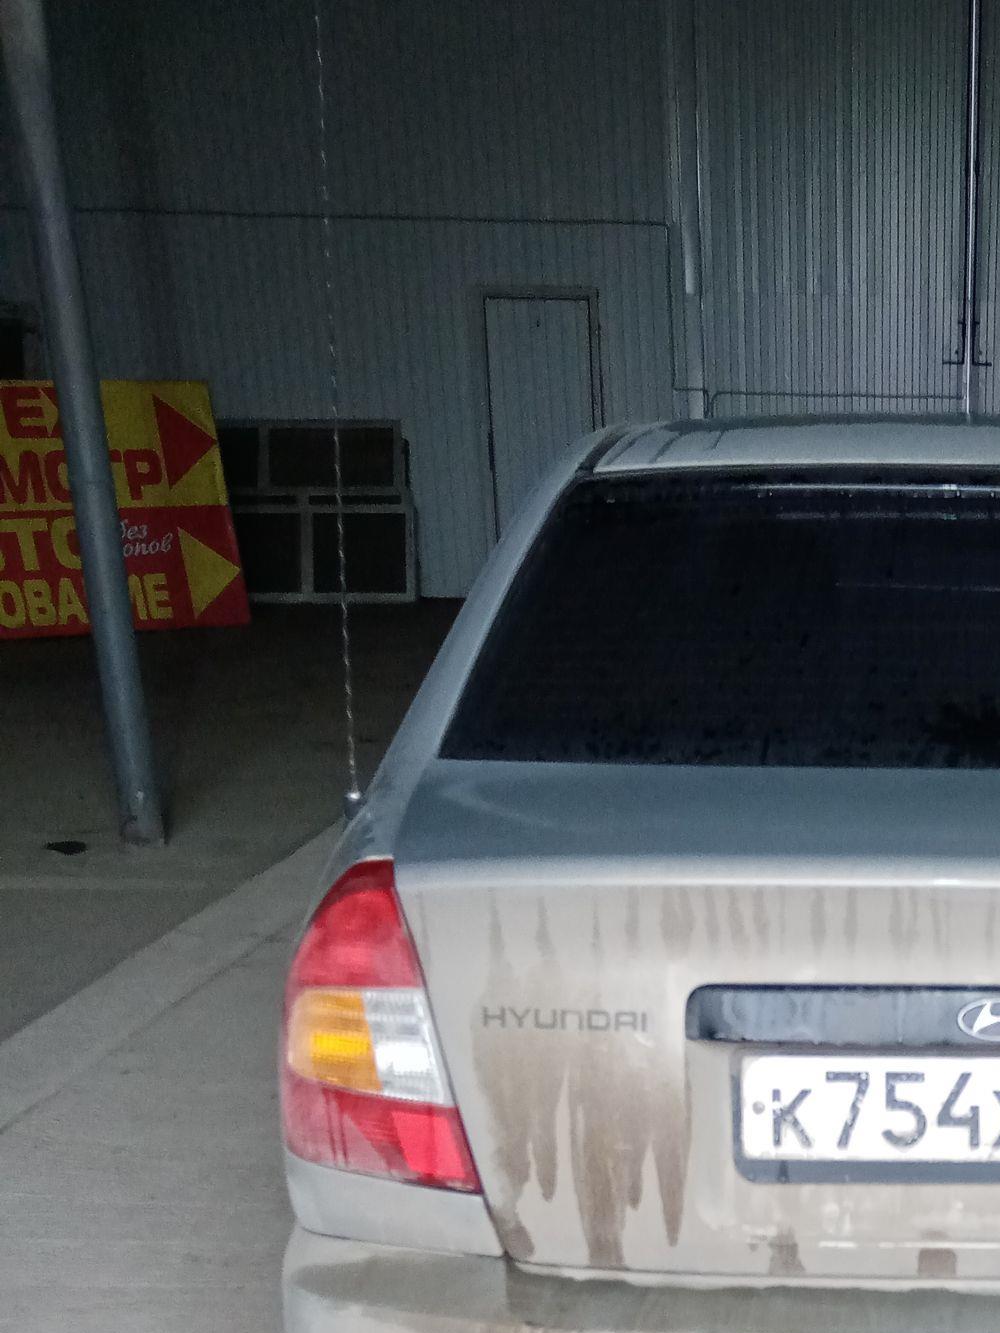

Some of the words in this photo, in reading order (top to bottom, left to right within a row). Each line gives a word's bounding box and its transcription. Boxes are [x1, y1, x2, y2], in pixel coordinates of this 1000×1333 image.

[0, 448, 164, 502] МОР
[0, 516, 82, 571] ТО
[0, 573, 174, 629] ОВАИЕ
[481, 1005, 648, 1032] HYUNDAI
